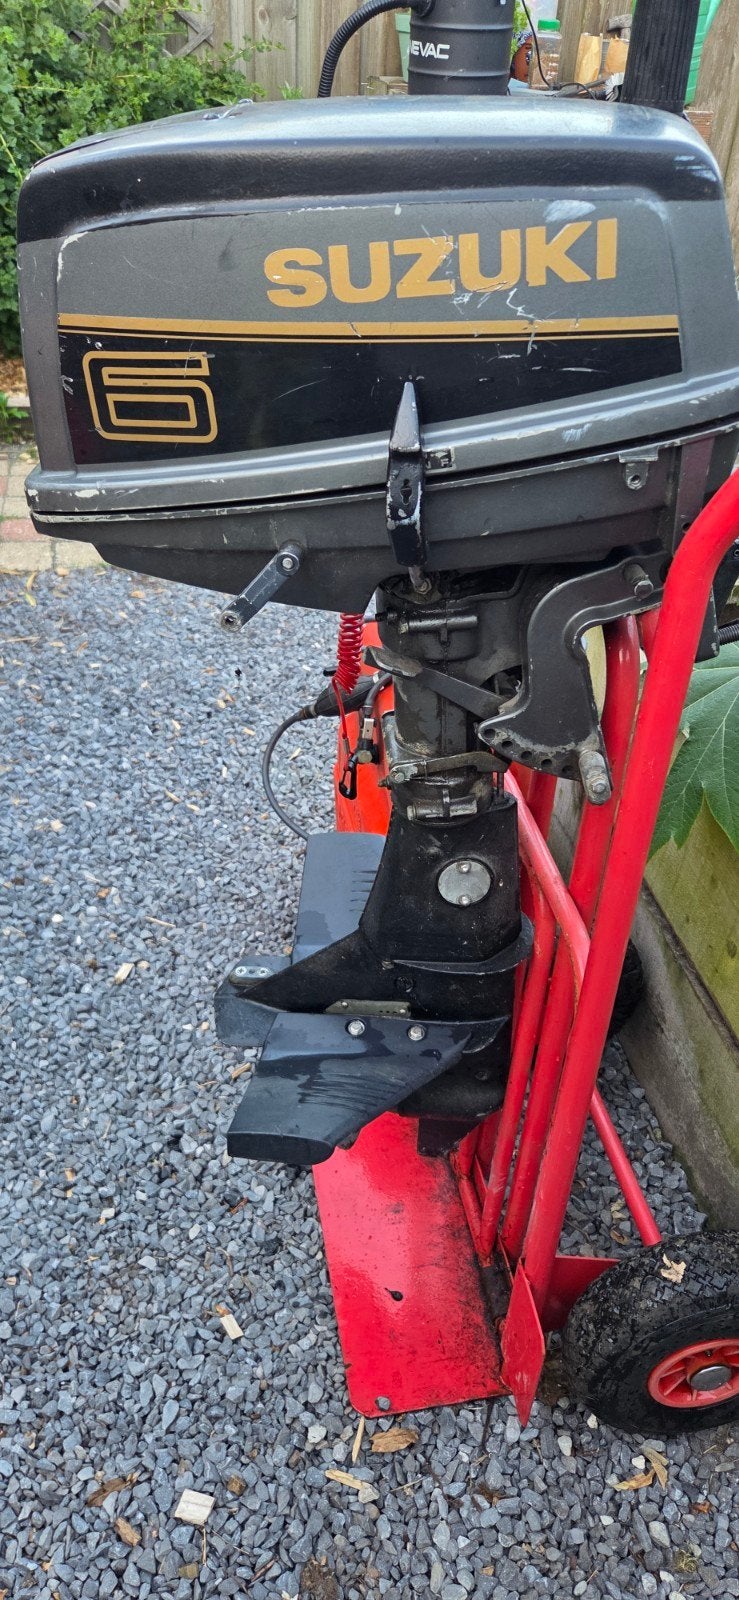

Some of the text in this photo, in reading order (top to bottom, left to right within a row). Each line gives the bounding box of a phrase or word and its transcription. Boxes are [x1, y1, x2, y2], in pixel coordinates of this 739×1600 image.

[408, 39, 451, 60] EVAC
[264, 218, 618, 308] SUZUKI
[82, 350, 218, 444] 6
